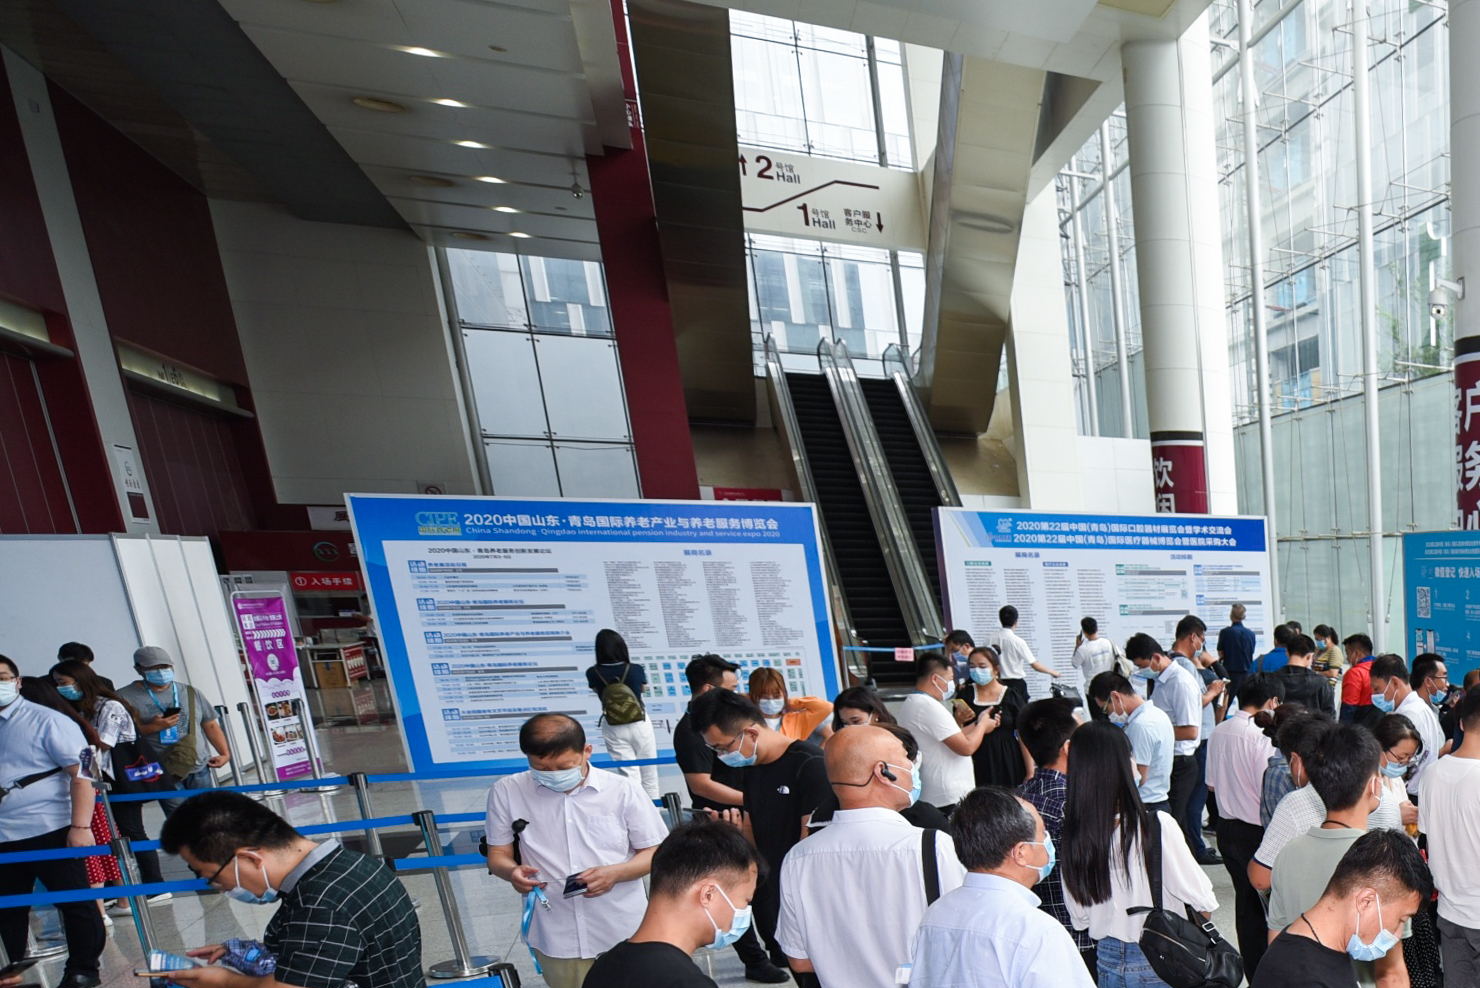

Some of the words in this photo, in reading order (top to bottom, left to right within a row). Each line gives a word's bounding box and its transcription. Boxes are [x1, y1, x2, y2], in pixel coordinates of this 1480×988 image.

[755, 155, 774, 180] 2
[776, 162, 794, 173] 号馆
[776, 171, 800, 184] Hall
[797, 203, 810, 226] 1
[812, 208, 829, 219] 号馆
[812, 217, 836, 230] Hall
[493, 527, 537, 536] Shandong
[541, 528, 576, 536] Qingdao
[665, 530, 697, 538] industry
